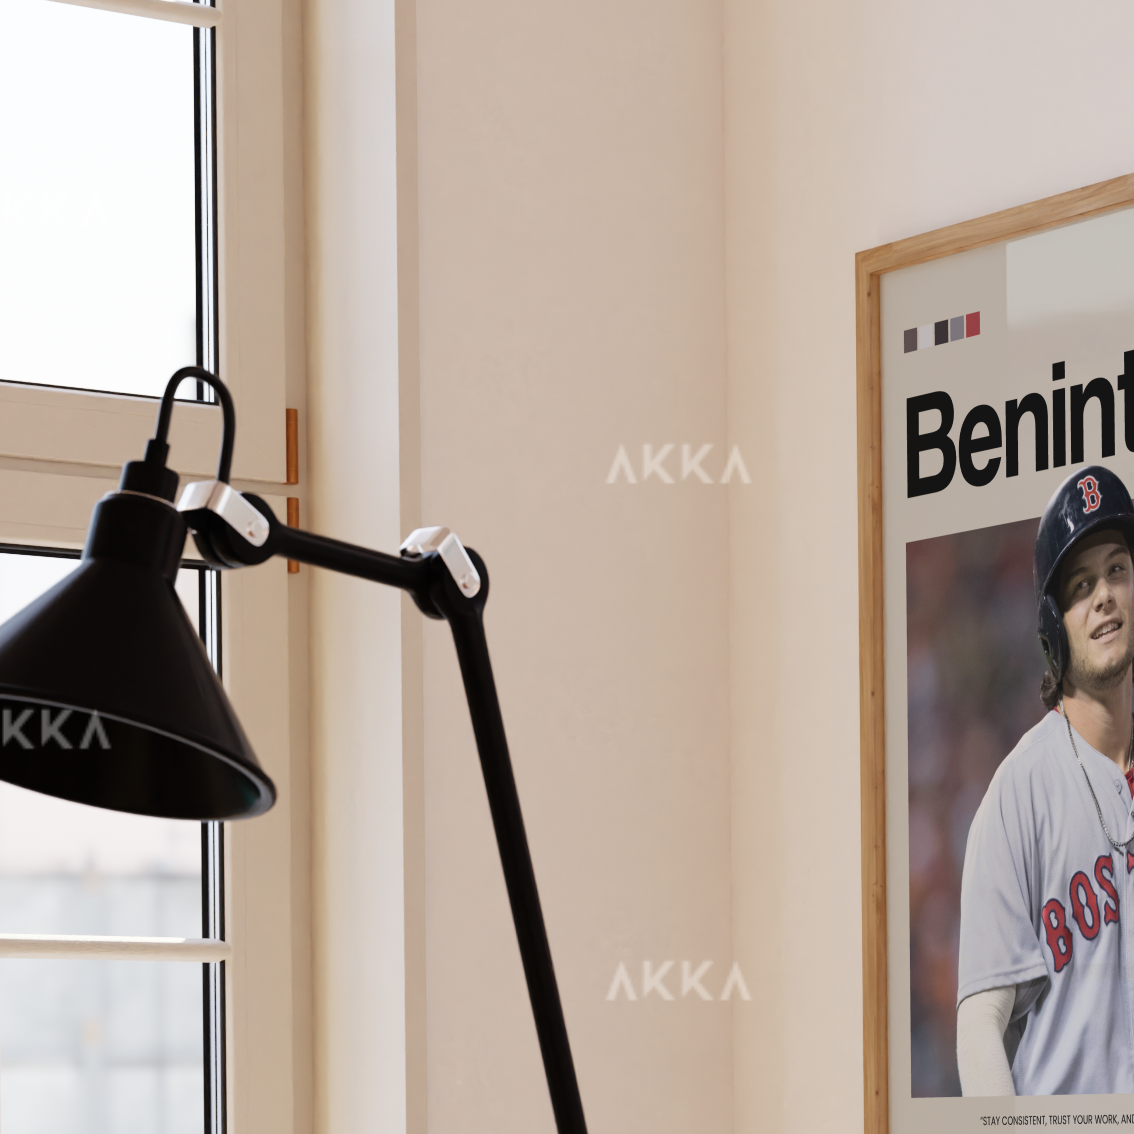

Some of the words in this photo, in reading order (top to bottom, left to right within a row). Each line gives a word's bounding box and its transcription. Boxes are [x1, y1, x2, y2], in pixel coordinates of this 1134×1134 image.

[1077, 475, 1102, 514] B
[1001, 1115, 1048, 1127] CONSISTENT,
[1048, 1114, 1071, 1125] TRUST
[1072, 1114, 1093, 1125] YOUR
[1094, 1113, 1120, 1126] WORK,
